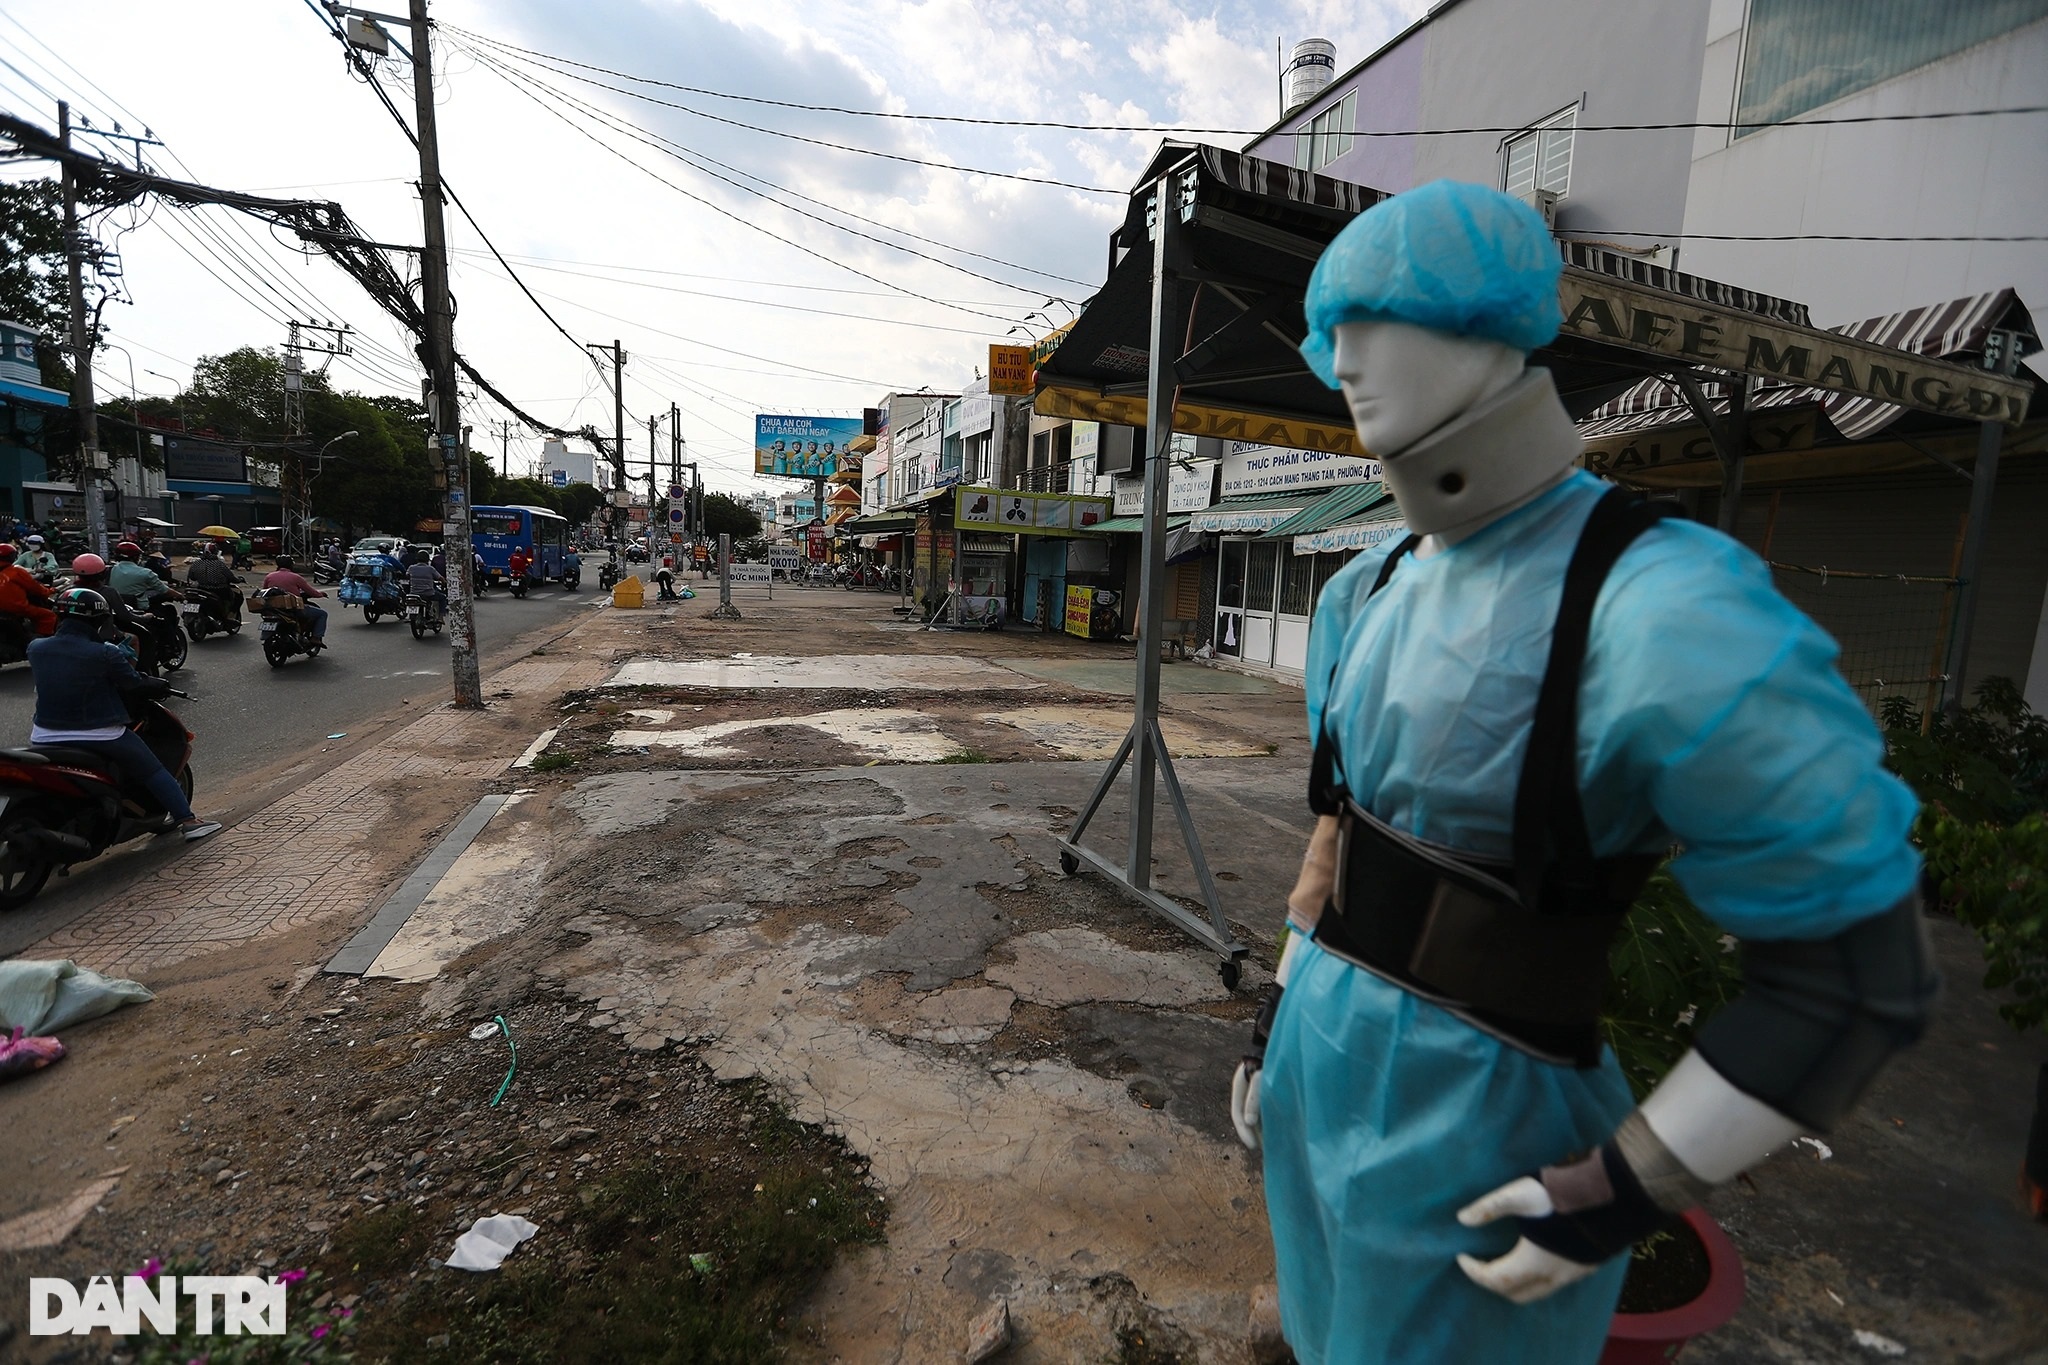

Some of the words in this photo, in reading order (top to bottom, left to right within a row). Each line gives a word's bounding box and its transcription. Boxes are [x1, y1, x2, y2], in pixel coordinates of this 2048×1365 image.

[1564, 294, 1725, 361] AFÉ
[1745, 334, 1952, 411] MANG
[993, 367, 1007, 378] NAM
[1008, 368, 1025, 380] VANG
[777, 427, 807, 436] BAEMIN
[810, 428, 830, 437] NGAY
[1584, 441, 1660, 472] RÁI
[1681, 424, 1806, 459] CY
[1247, 457, 1269, 472] THỰC
[1273, 450, 1299, 467] PHẨM
[1243, 479, 1253, 489] 1212
[1258, 477, 1268, 487] 1214
[1269, 474, 1284, 486] CÁCH
[1284, 473, 1300, 486] MẠNG
[1301, 469, 1320, 482] THÁNG
[1337, 464, 1363, 478] PHƯỜNG
[1364, 464, 1371, 480] 4
[769, 548, 780, 556] NHÀ
[782, 547, 798, 556] THUỐC
[770, 558, 798, 568] OKOTO
[730, 572, 747, 581] ĐỨC
[748, 574, 769, 582] MINH
